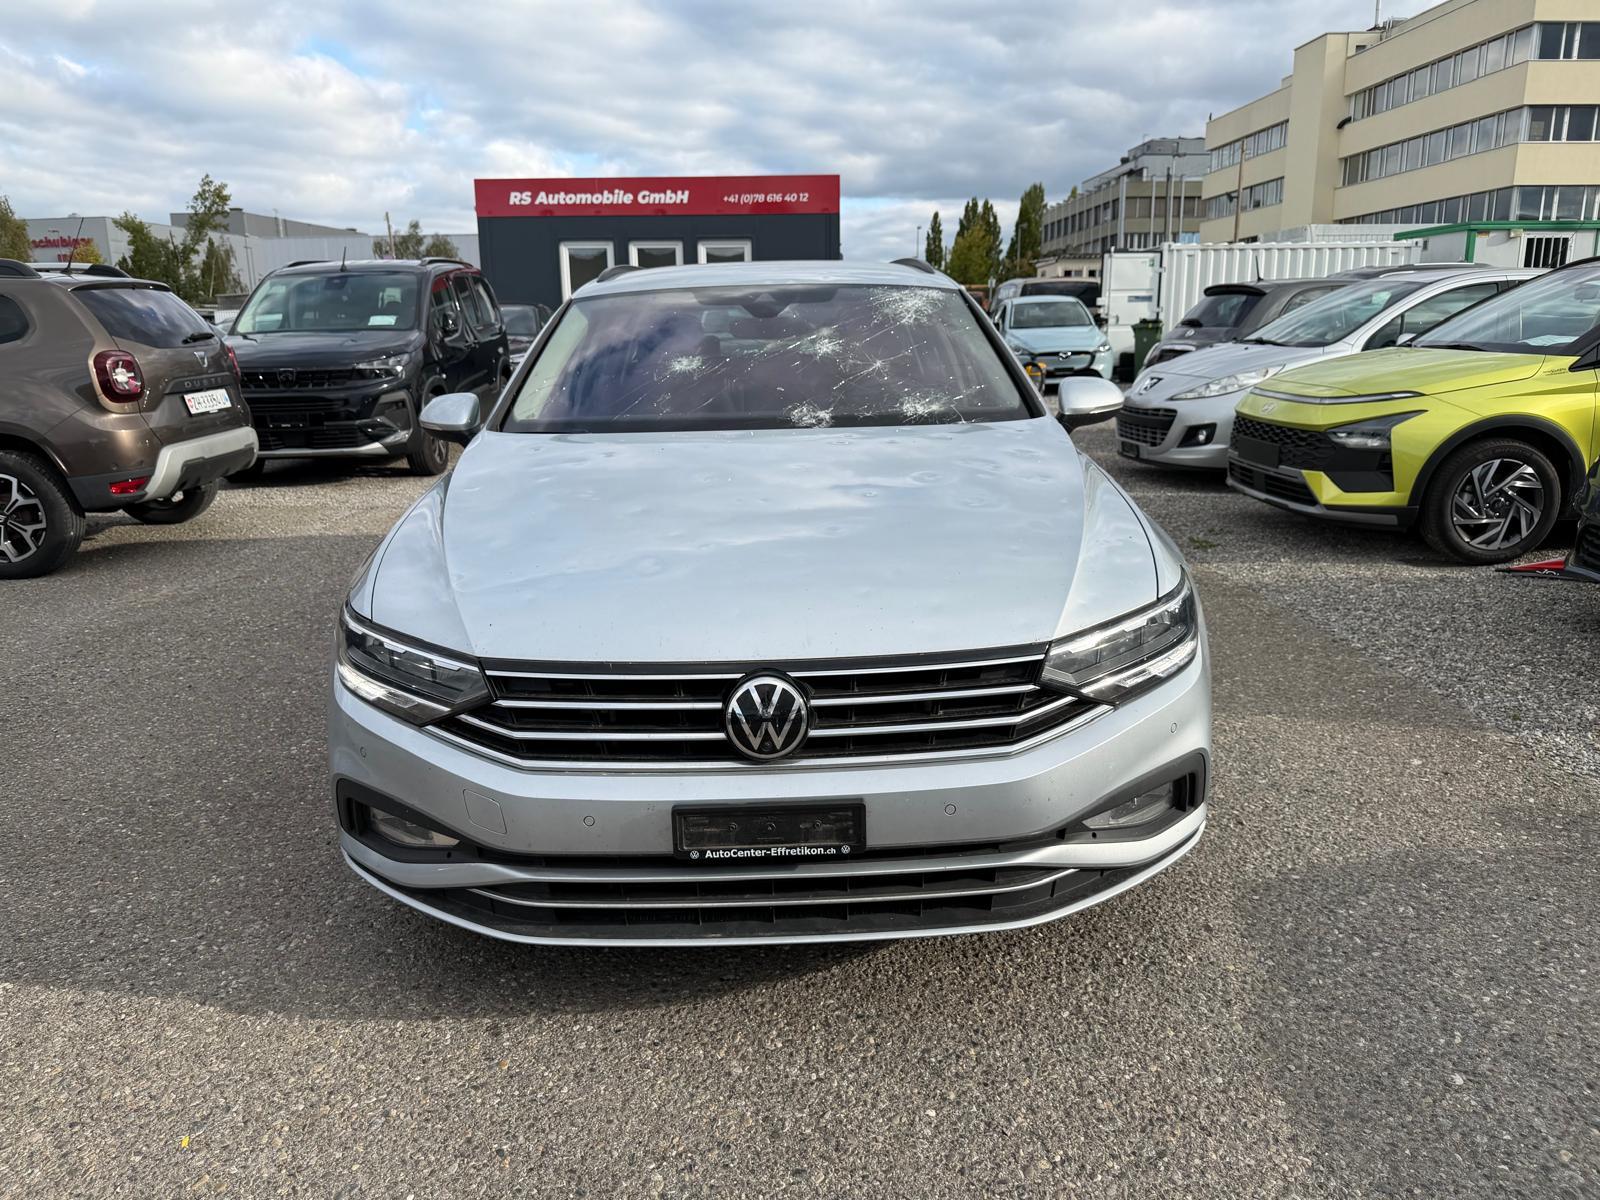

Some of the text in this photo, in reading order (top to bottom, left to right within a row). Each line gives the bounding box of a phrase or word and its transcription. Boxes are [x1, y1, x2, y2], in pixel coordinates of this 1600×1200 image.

[509, 189, 690, 205] RS Automobile GmbH
[723, 192, 809, 205] +41 (0)78 616 40 12
[704, 846, 836, 859] AutoCenter-Effretikon.ch
